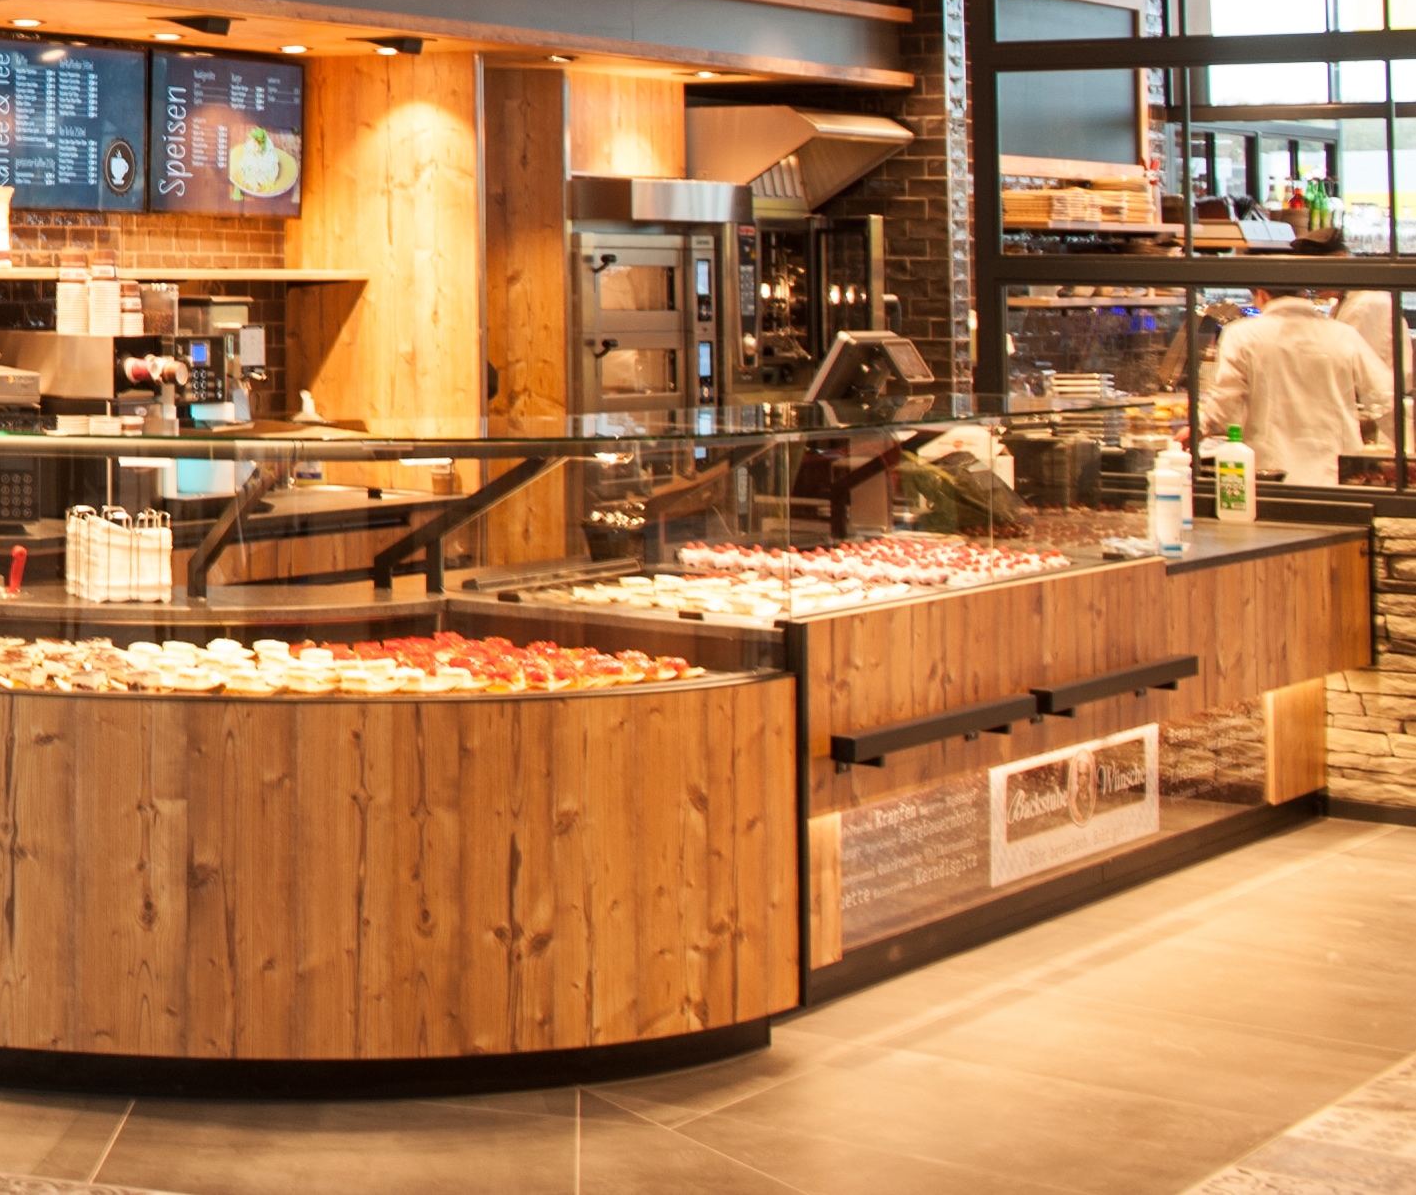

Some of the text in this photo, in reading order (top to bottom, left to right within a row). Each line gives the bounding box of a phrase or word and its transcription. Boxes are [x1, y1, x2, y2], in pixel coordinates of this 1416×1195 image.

[158, 86, 193, 197] Speisen
[1006, 759, 1147, 825] Backstube Wünsche
[873, 801, 917, 828] Krapfen
[899, 807, 978, 844] Bergbauernbrot
[915, 852, 978, 886] Kerndlspitz
